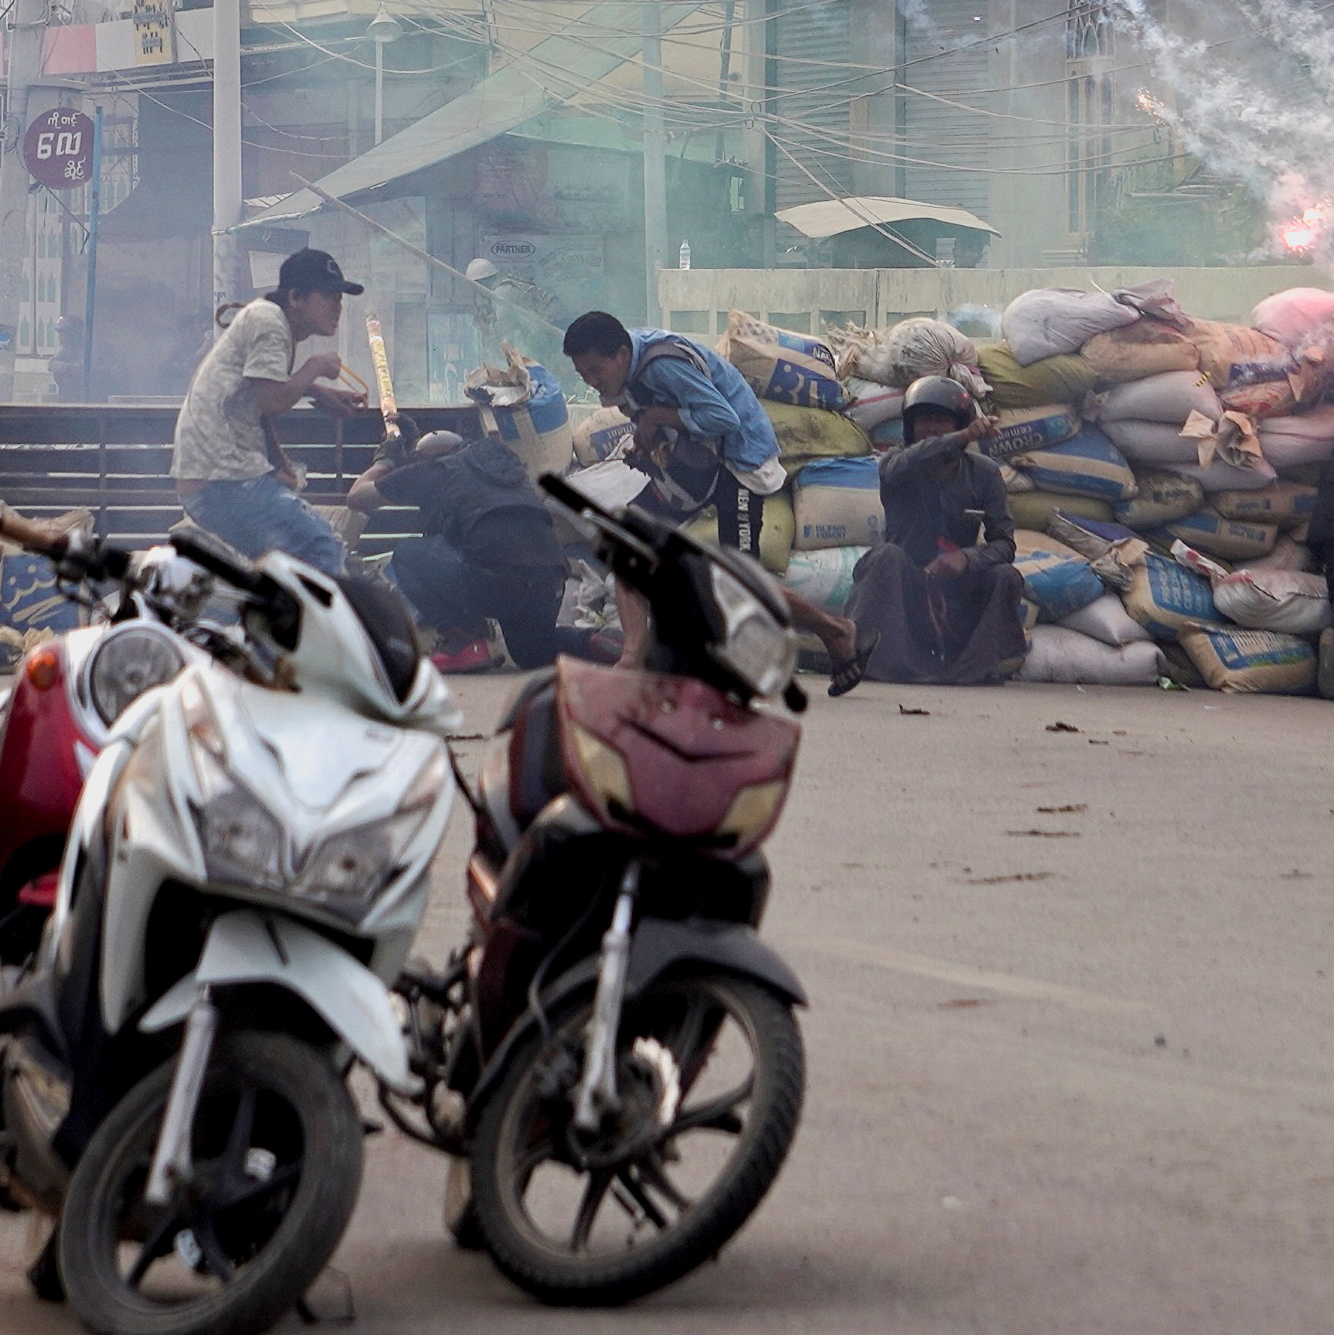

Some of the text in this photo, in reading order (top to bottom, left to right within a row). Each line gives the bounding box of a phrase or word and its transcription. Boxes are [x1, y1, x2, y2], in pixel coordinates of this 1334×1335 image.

[495, 245, 531, 254] PARTNER
[988, 432, 1044, 457] CROWN
[738, 522, 751, 552] YORK
